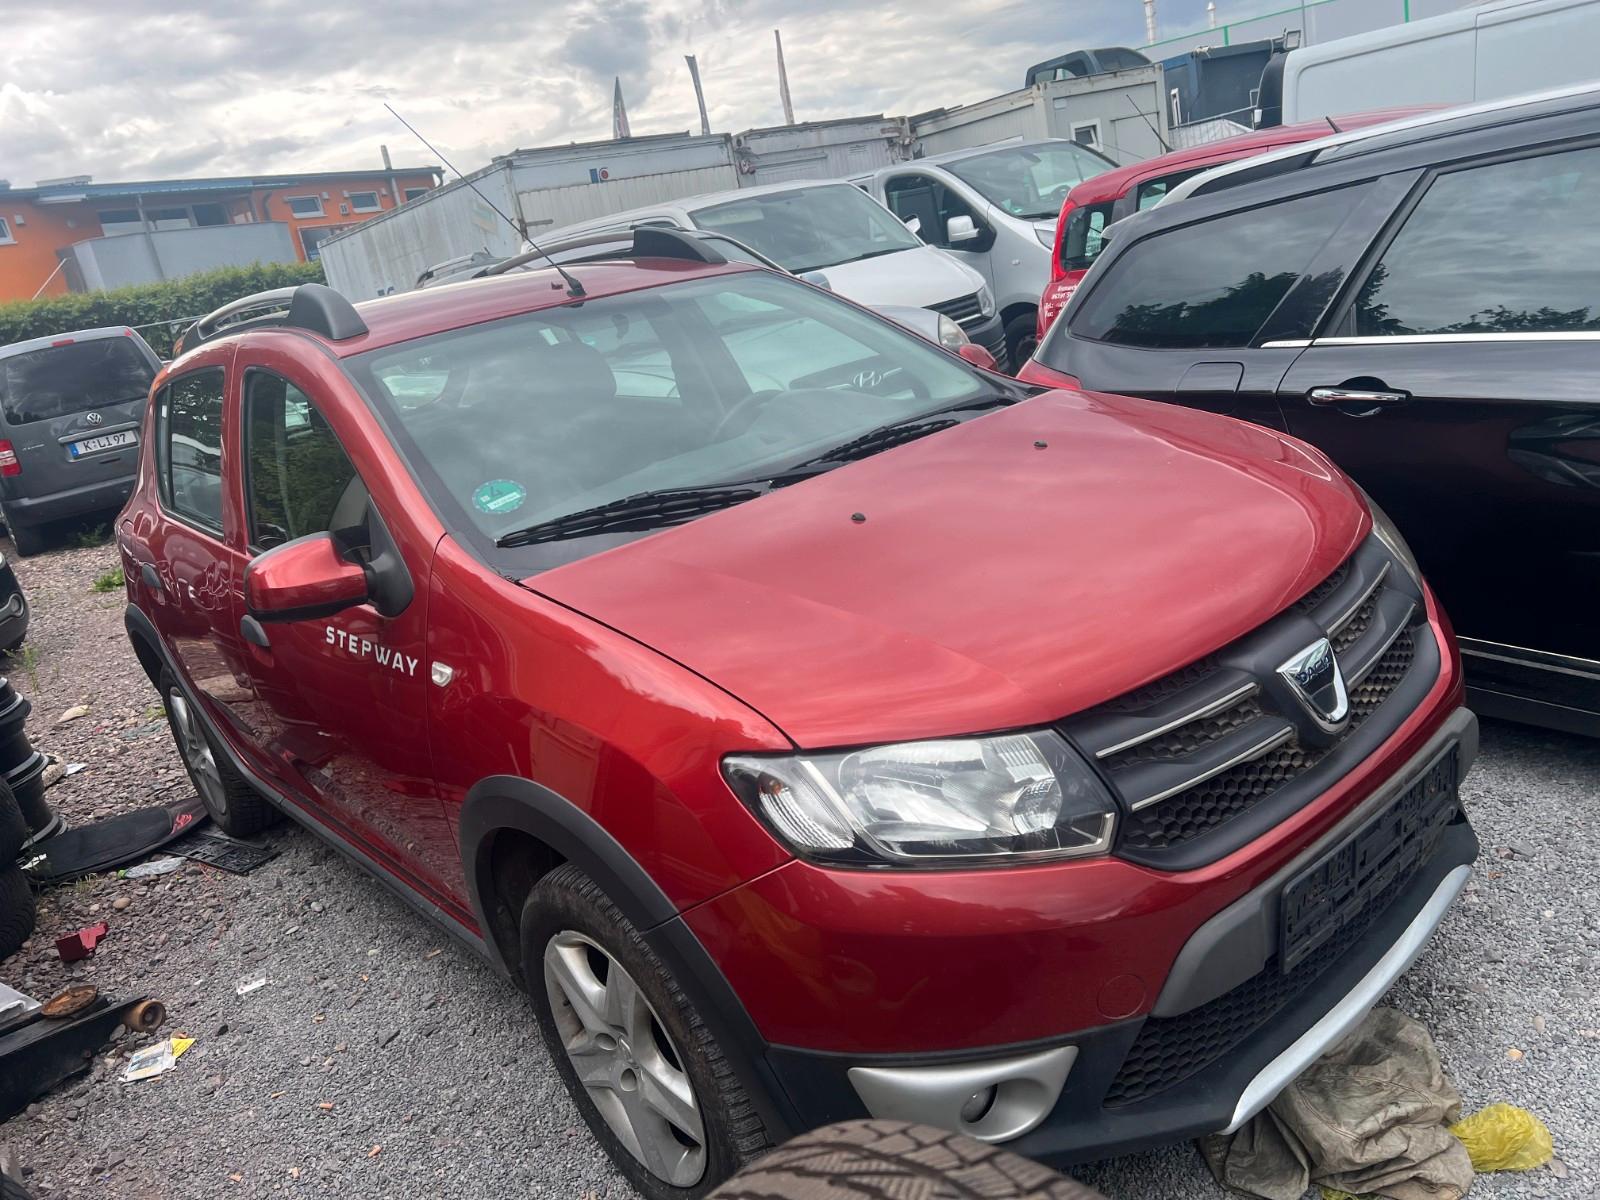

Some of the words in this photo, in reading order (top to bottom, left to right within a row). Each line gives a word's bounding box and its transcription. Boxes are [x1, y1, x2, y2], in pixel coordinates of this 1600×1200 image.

[113, 433, 126, 444] 97
[326, 625, 418, 677] STEPWAY
[1296, 655, 1331, 685] DACIA
